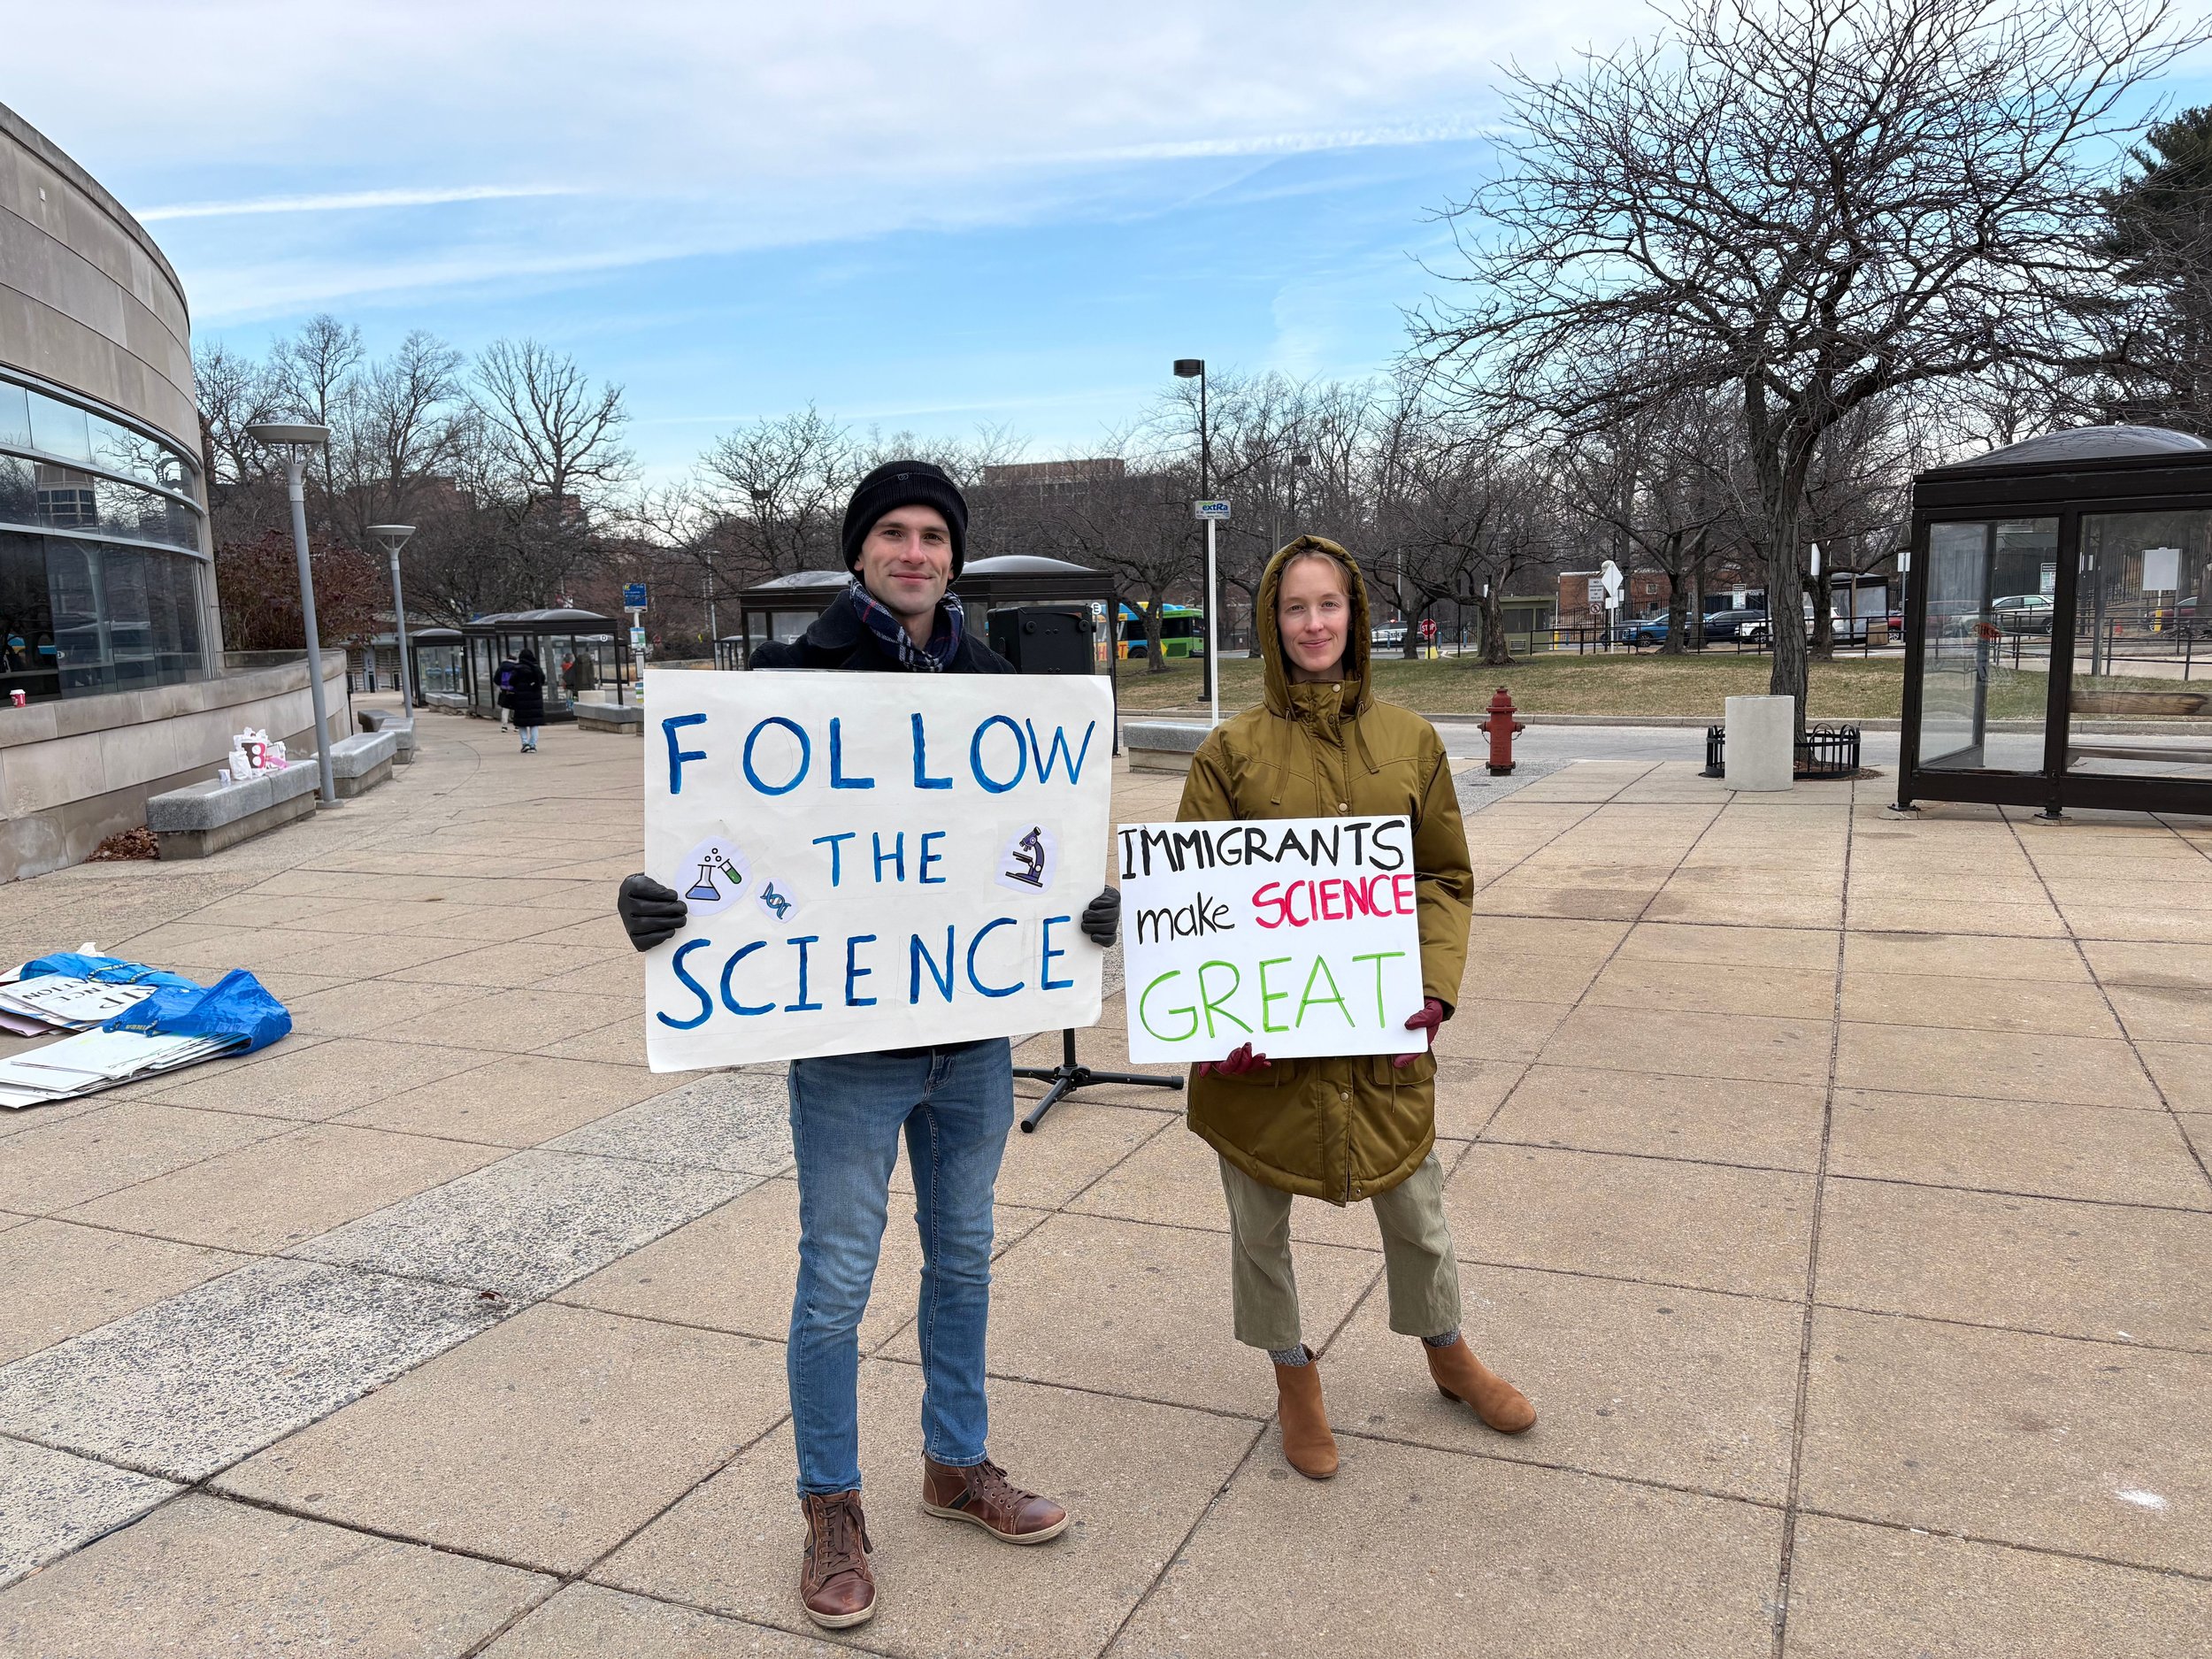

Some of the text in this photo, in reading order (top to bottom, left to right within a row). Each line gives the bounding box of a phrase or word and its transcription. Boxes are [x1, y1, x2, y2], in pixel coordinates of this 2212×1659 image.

[662, 713, 1094, 795] FOLLOW
[813, 831, 947, 887] THE
[1118, 819, 1406, 879] IMMIGRANTS
[1138, 874, 1415, 944] make SCIENCE
[21, 979, 88, 1001] ATION
[54, 984, 116, 1002] ENCE
[657, 915, 1074, 1030] SCIENCE
[1140, 952, 1405, 1041] GREAT
